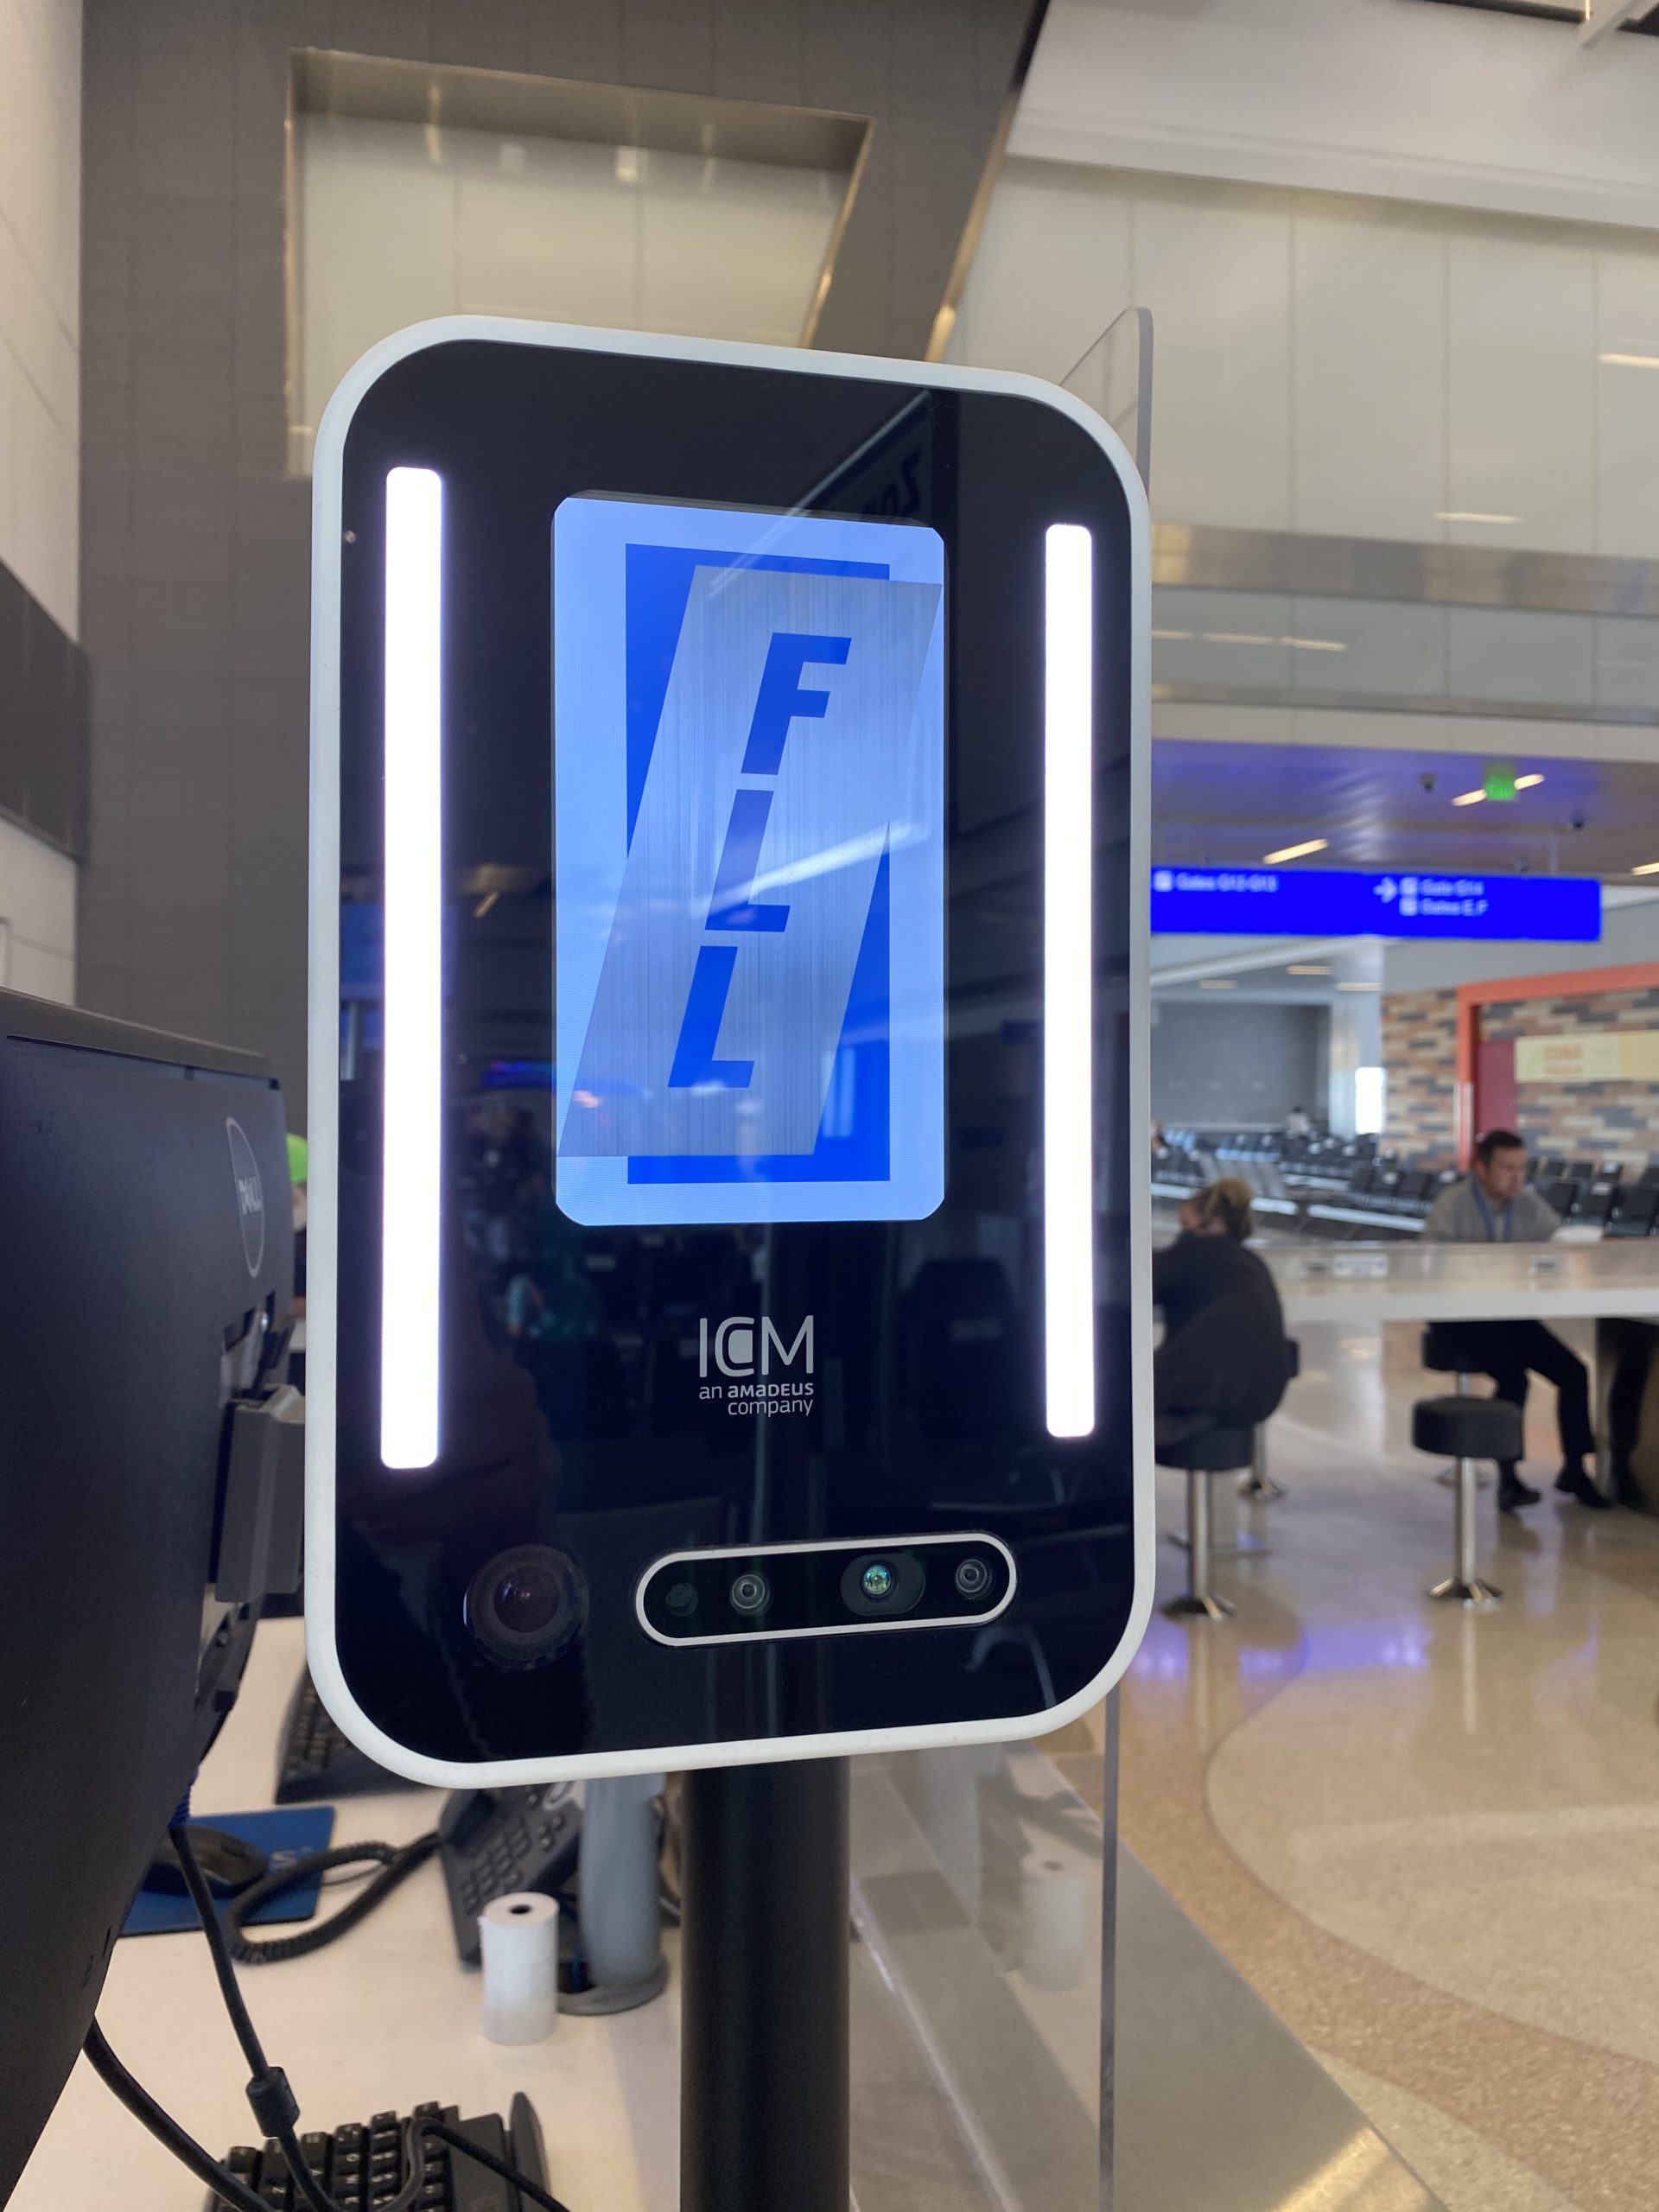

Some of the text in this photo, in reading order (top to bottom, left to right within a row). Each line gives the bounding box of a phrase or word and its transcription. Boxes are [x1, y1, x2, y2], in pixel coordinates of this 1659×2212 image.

[669, 632, 852, 1089] FLL
[699, 1315, 814, 1377] ICM
[699, 1386, 722, 1400] an
[728, 1399, 814, 1418] company
